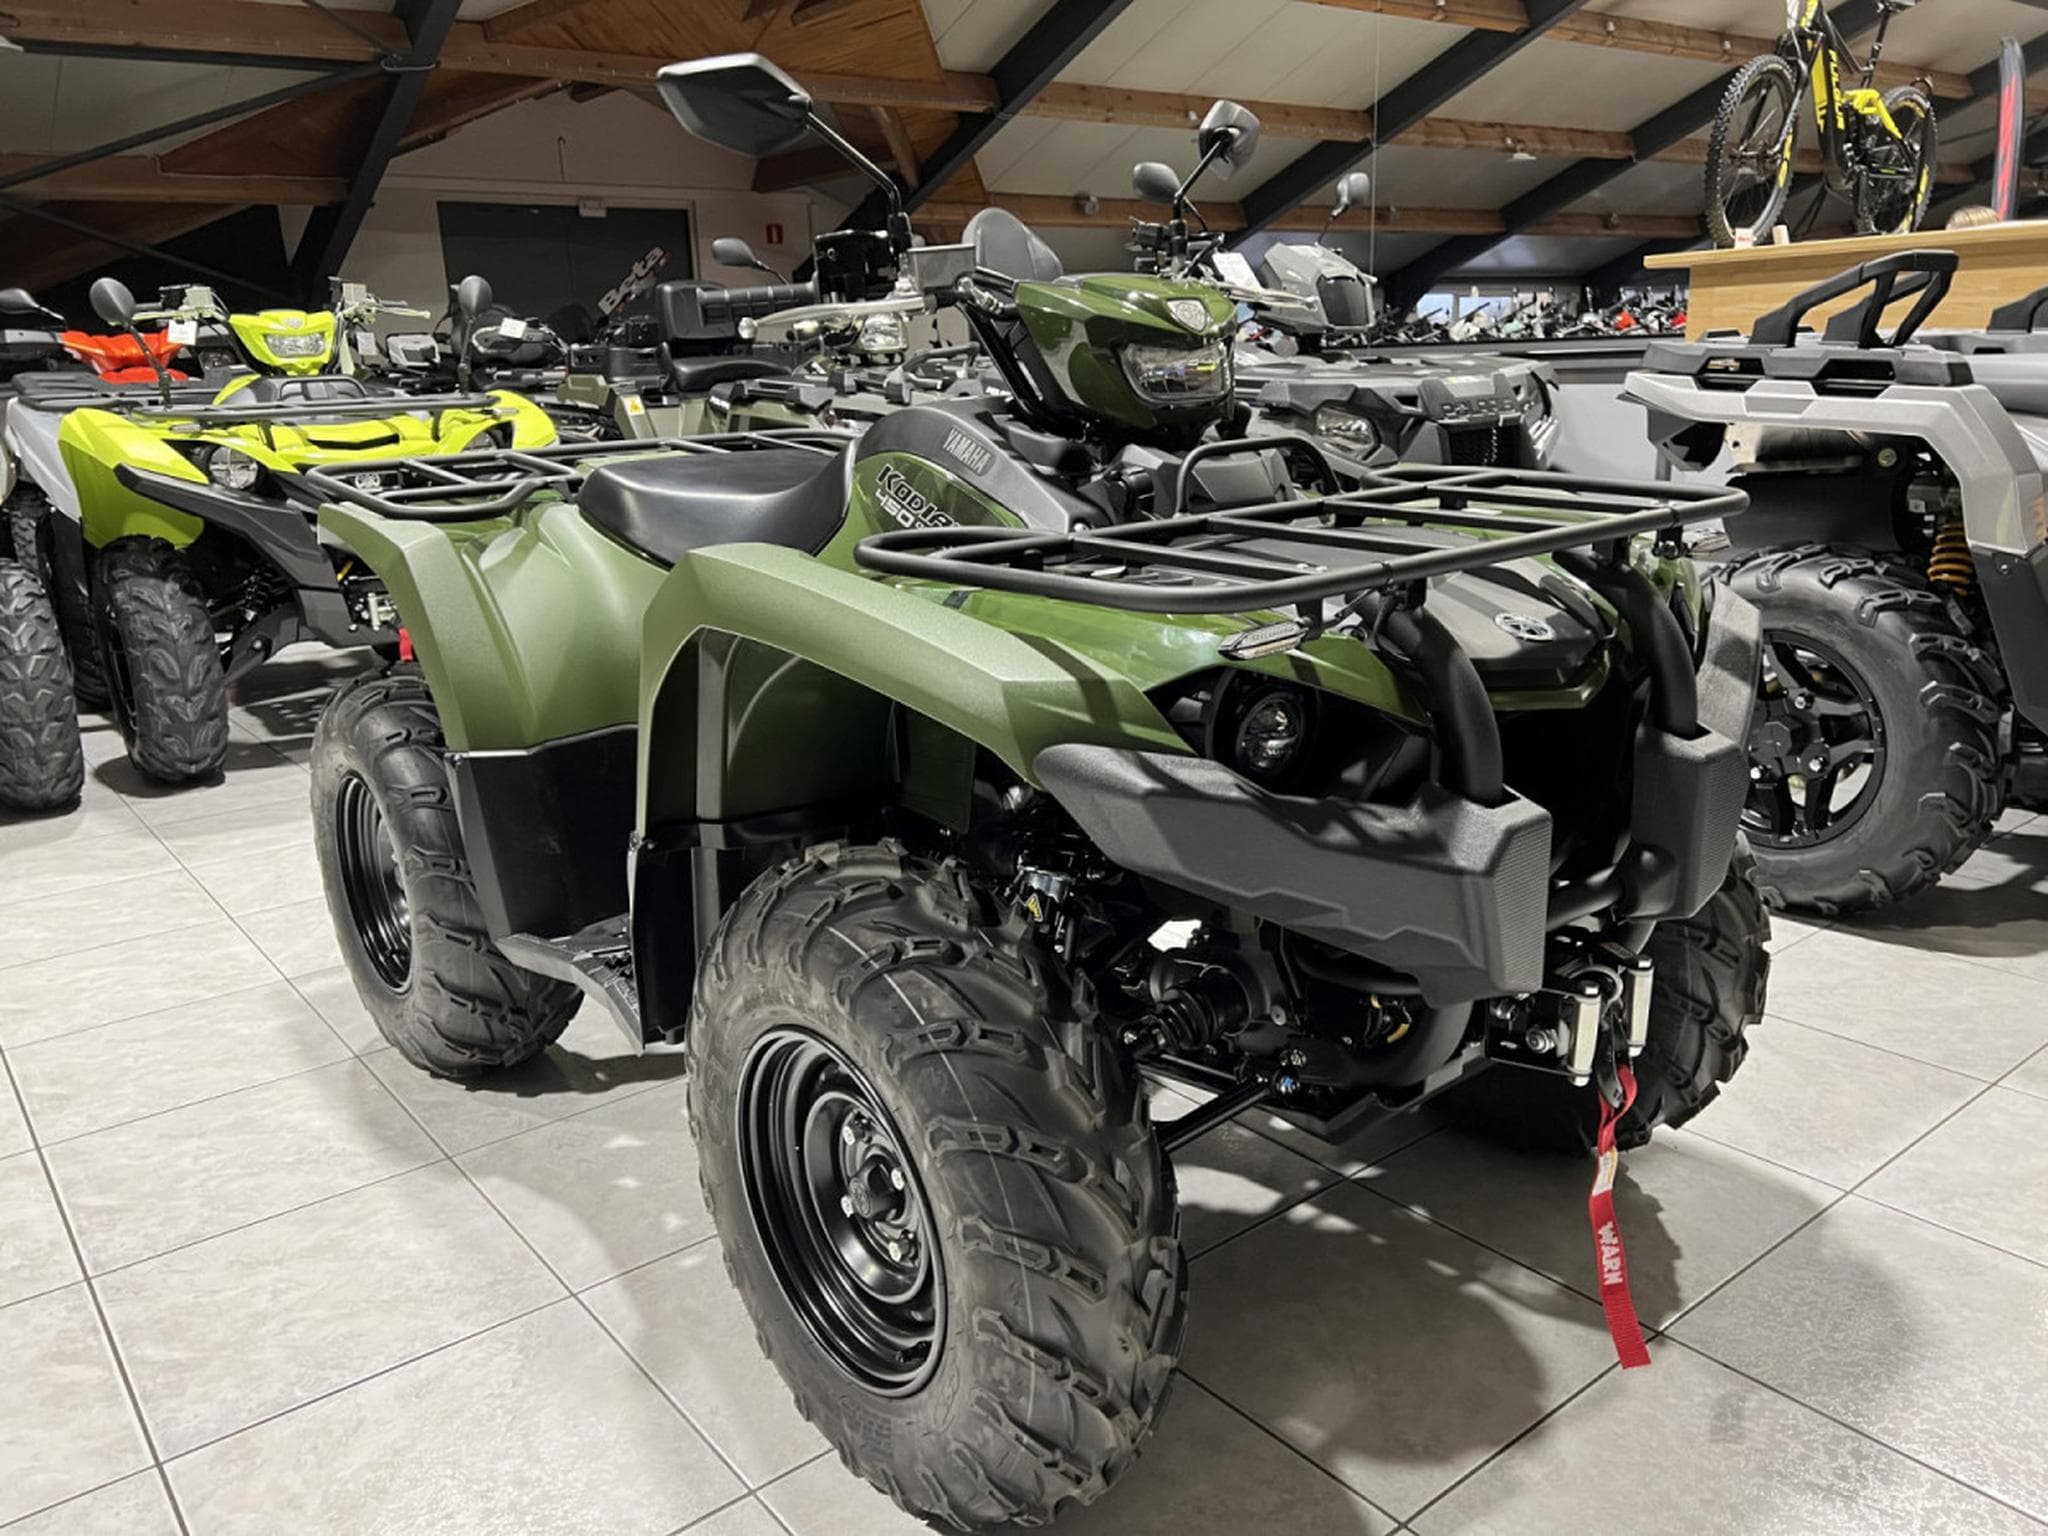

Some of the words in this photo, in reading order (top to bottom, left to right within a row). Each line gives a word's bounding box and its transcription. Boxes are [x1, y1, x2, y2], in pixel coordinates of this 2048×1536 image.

[598, 247, 664, 315] Beta
[943, 427, 992, 475] YAMAHA
[876, 463, 960, 528] KODIA
[1598, 1221, 1624, 1286] WARN
